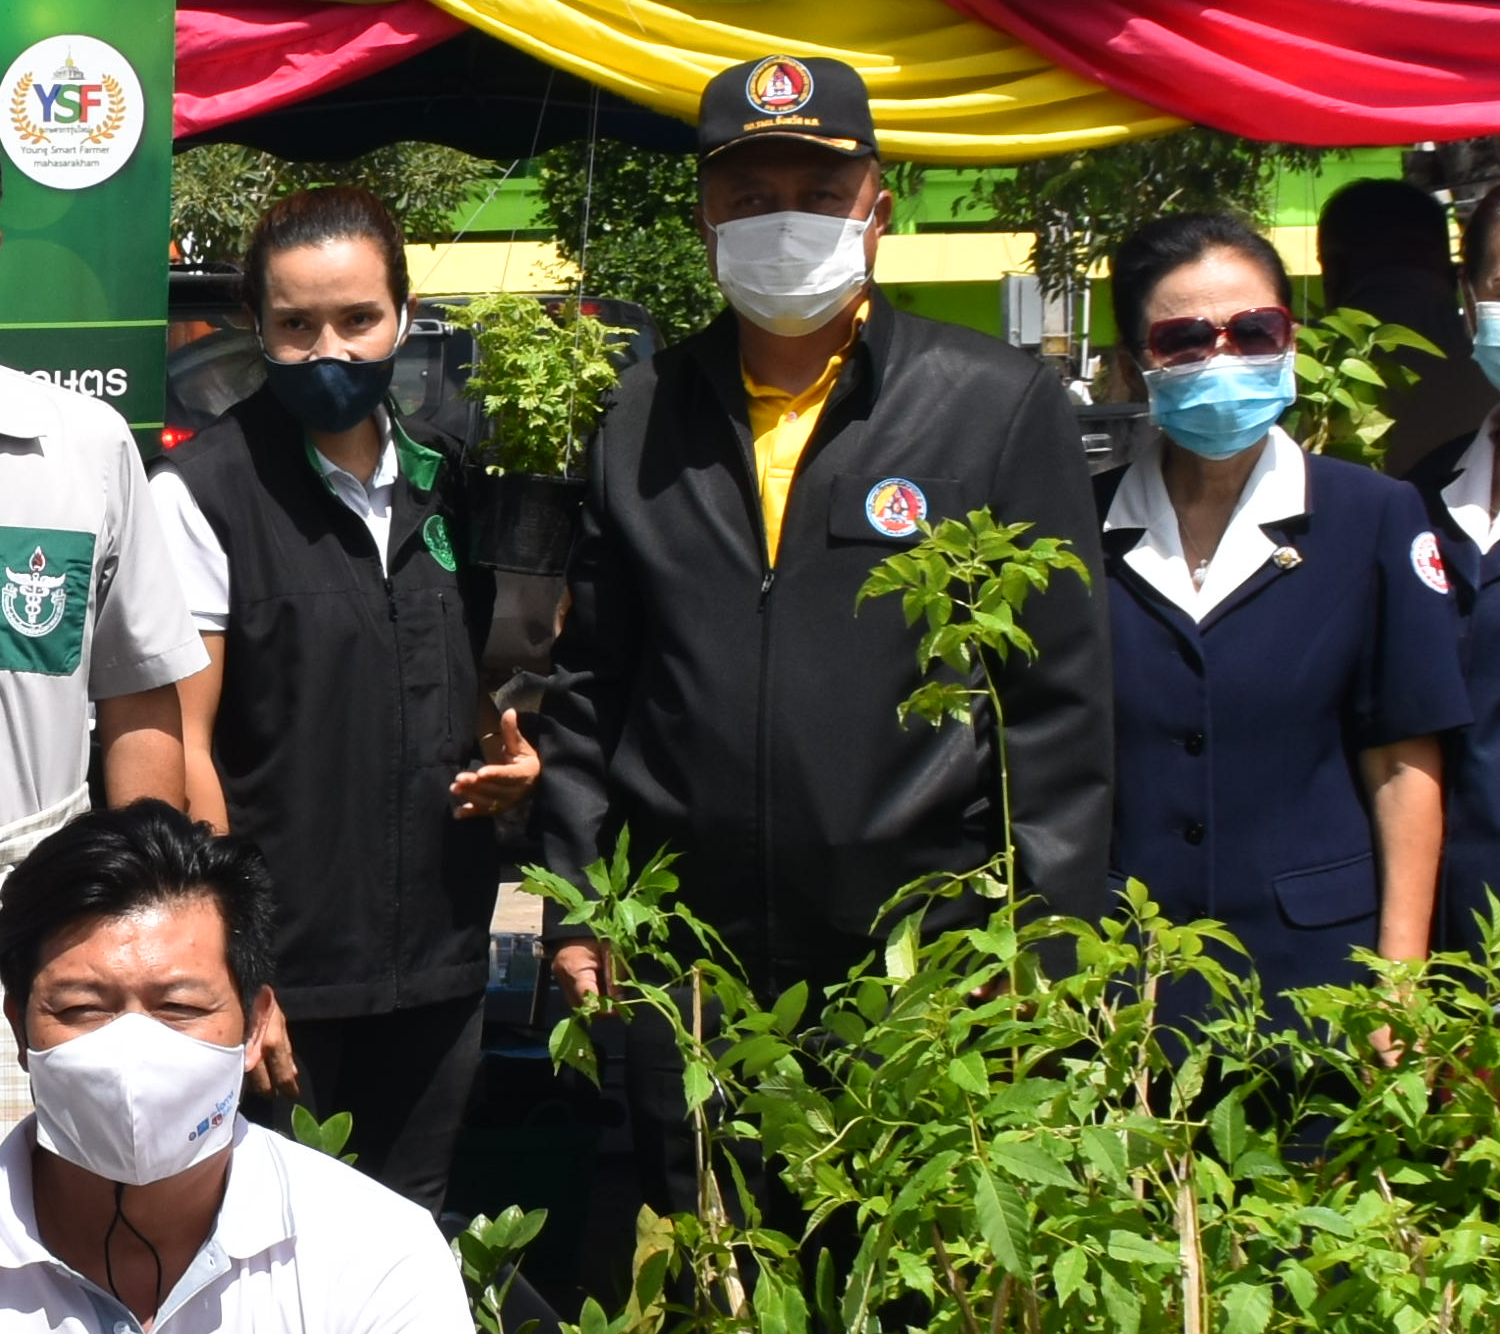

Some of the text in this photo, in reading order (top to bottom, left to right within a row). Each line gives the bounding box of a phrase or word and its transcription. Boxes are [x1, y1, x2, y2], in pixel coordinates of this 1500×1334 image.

[33, 83, 104, 125] YSF
[20, 145, 110, 157] Young Smart Farmer
[33, 158, 100, 168] mahasarakham
